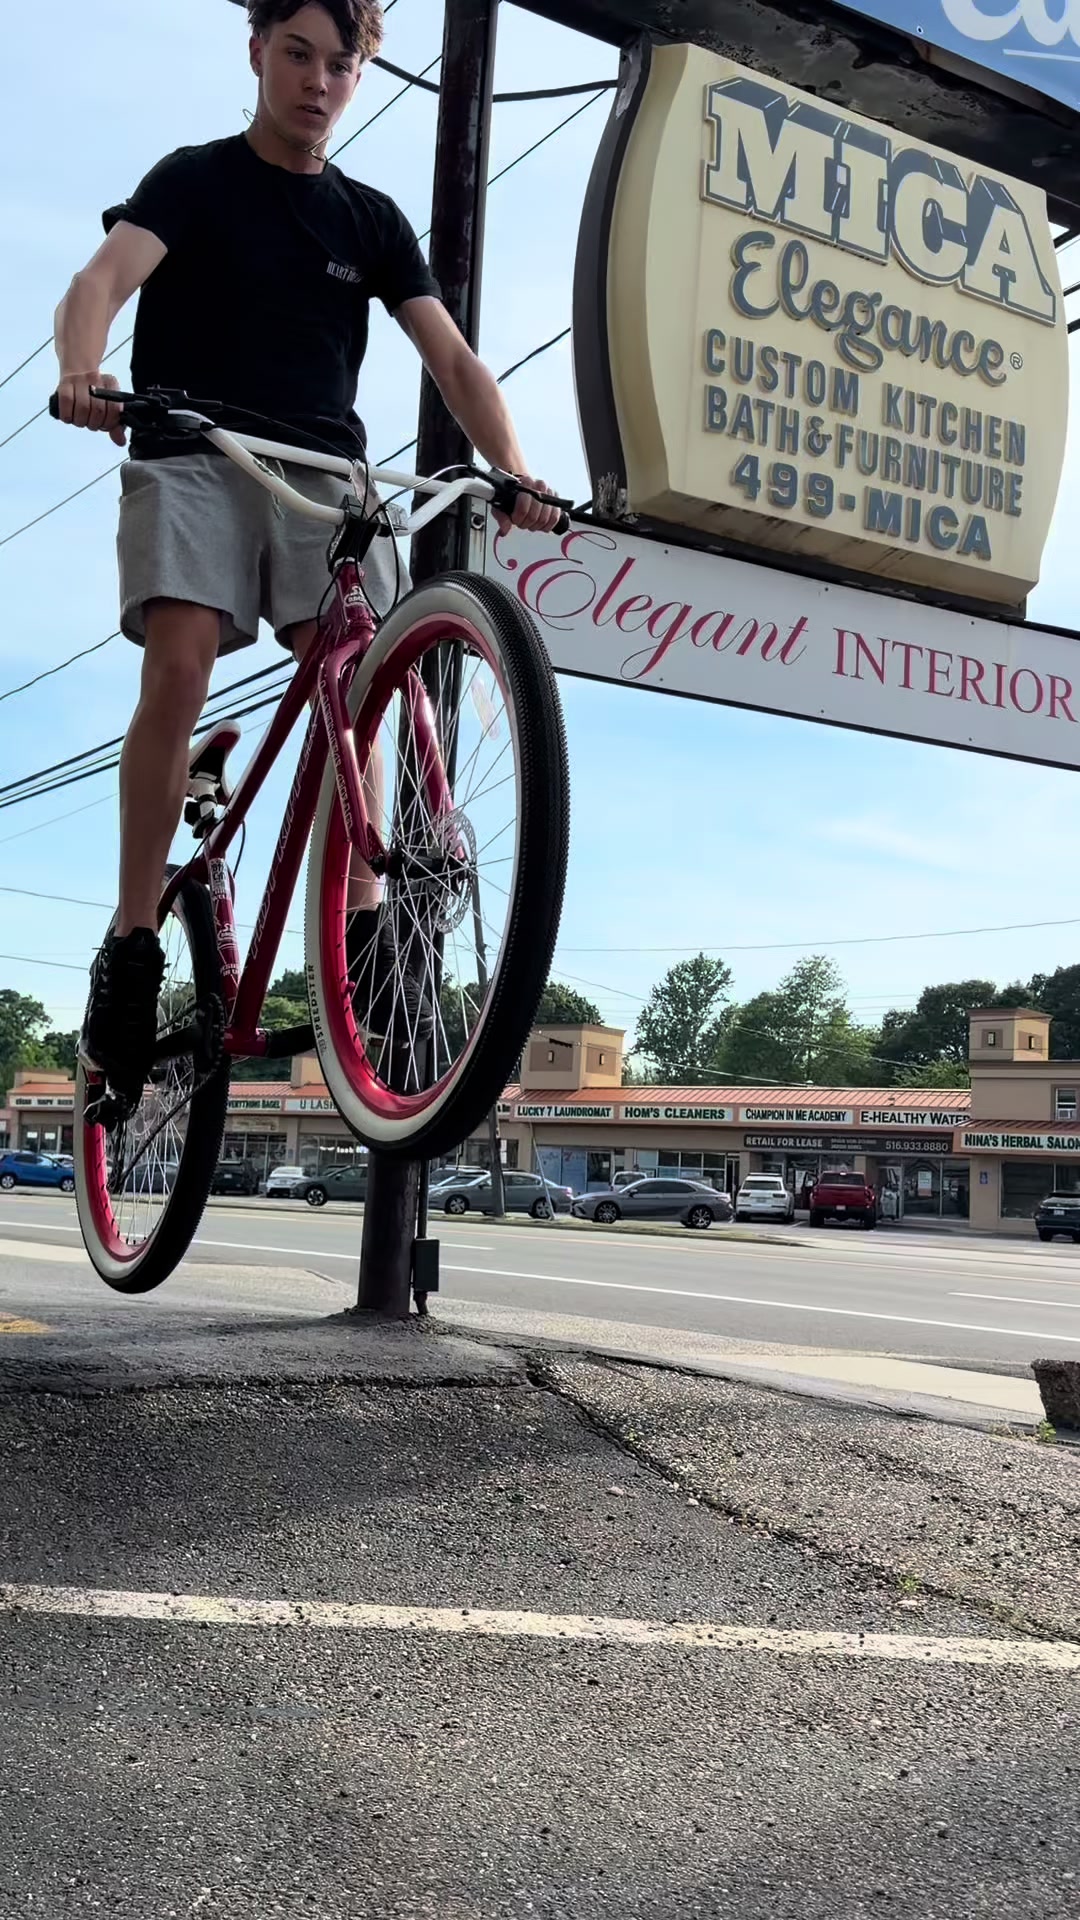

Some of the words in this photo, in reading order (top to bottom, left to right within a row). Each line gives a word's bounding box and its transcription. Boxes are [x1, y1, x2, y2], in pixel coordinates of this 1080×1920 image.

[701, 75, 1056, 328] MICA
[703, 328, 860, 418] CUSTOM
[880, 381, 1027, 467] KITCHEN
[731, 453, 993, 562] 499-MICA
[493, 529, 809, 681] Elegant
[831, 626, 1080, 723] INTERIOR
[307, 964, 324, 1039] SPEEDSTER
[517, 1105, 546, 1117] LUCKY
[546, 1105, 554, 1117] 7
[554, 1106, 612, 1118] LAUNDROMAT
[624, 1106, 660, 1119] HOM'S
[665, 1107, 725, 1120] CLEANERS
[745, 1108, 785, 1121] CHAMPION
[808, 1109, 847, 1122] ACADEMY
[860, 1110, 927, 1125] E-HEALTHY
[745, 1135, 775, 1146] RETAIL
[777, 1136, 795, 1147] FOR
[796, 1137, 823, 1148] LEASE
[885, 1140, 949, 1152] 516.933.8880
[964, 1133, 999, 1148] NINA'S
[1001, 1134, 1044, 1149] HERBAL
[1046, 1136, 1080, 1151] SALON
